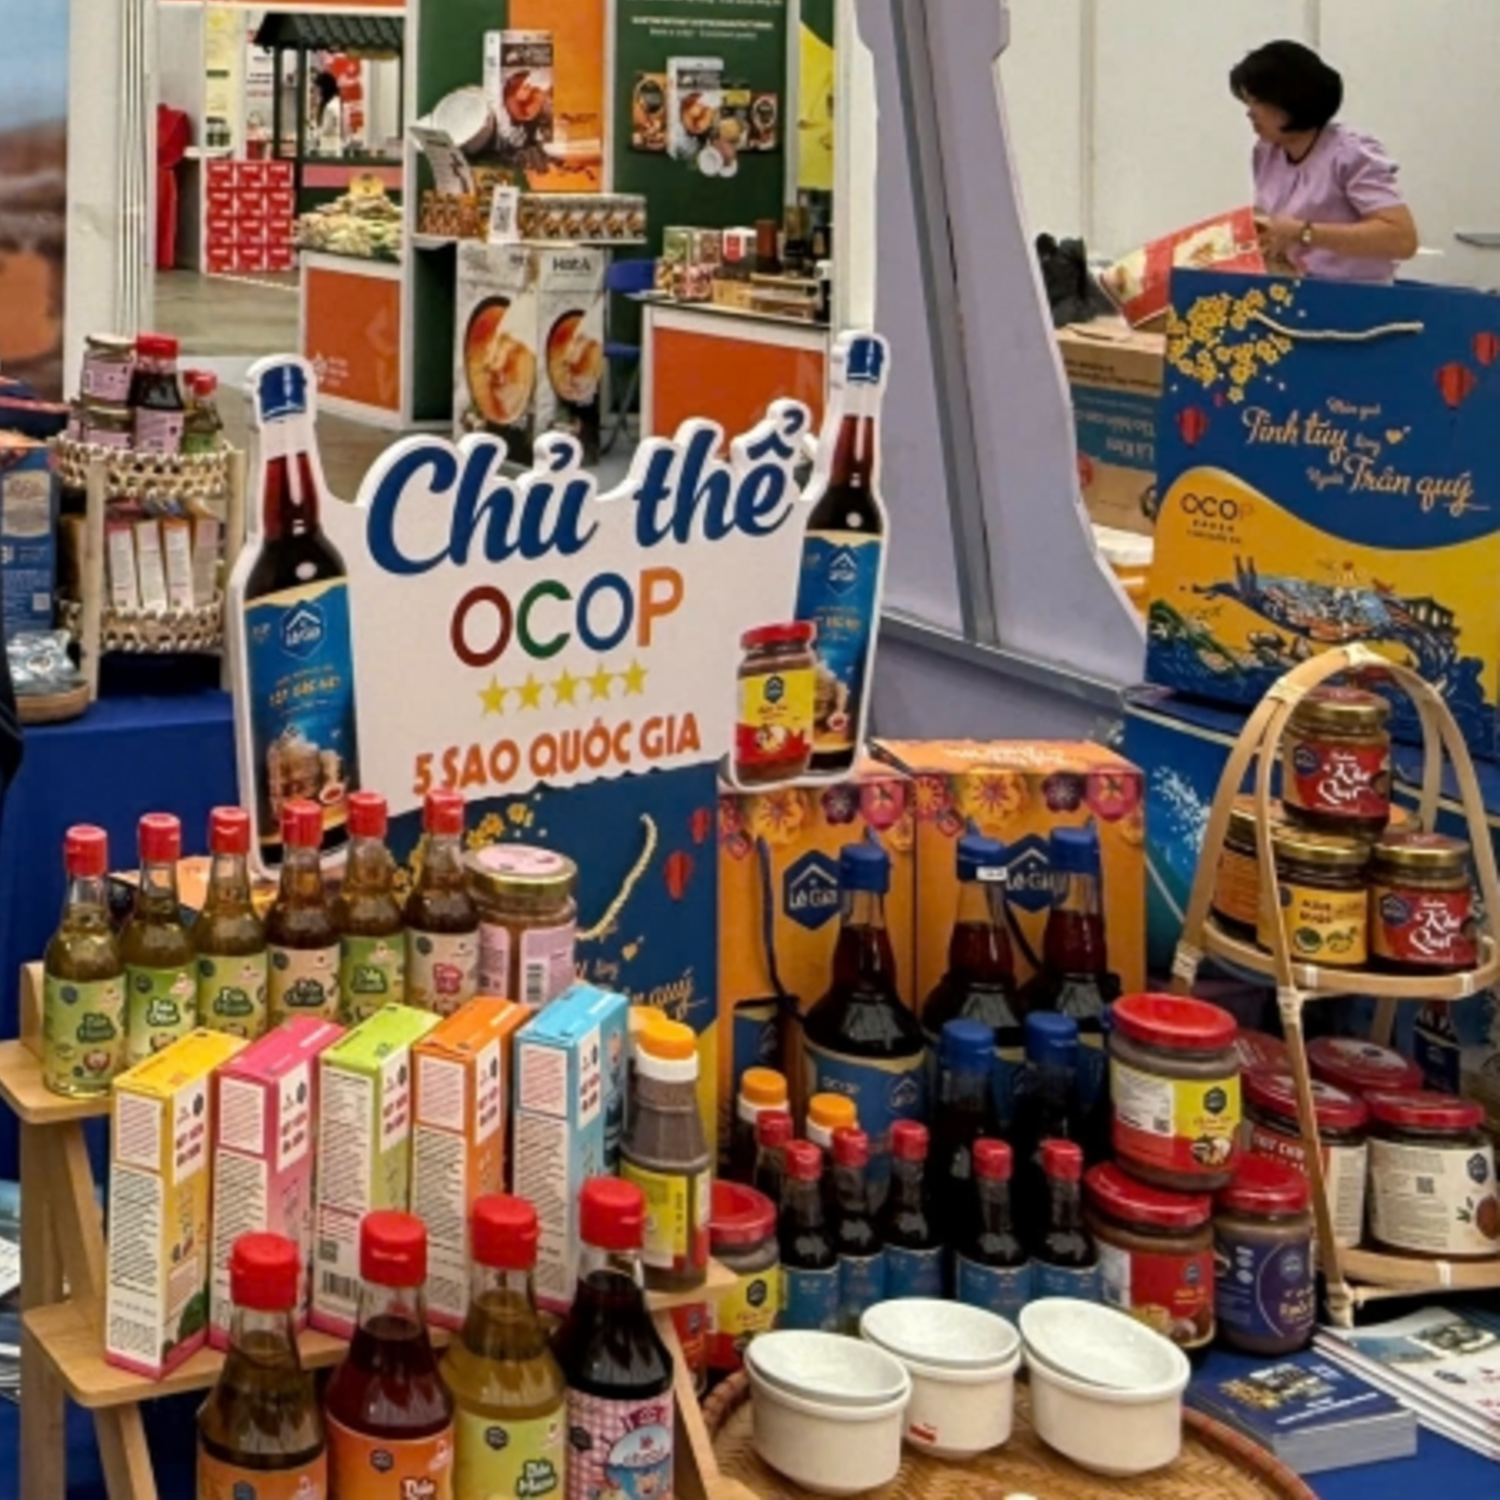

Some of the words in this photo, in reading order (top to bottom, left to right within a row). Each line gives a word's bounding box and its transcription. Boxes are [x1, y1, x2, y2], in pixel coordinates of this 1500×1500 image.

[365, 438, 599, 575] Chủ
[633, 407, 806, 550] thể
[450, 566, 685, 668] OCOP
[412, 752, 434, 796] 5
[440, 740, 521, 792] SAO
[528, 716, 631, 778] QUỐC
[638, 711, 701, 757] GIA
